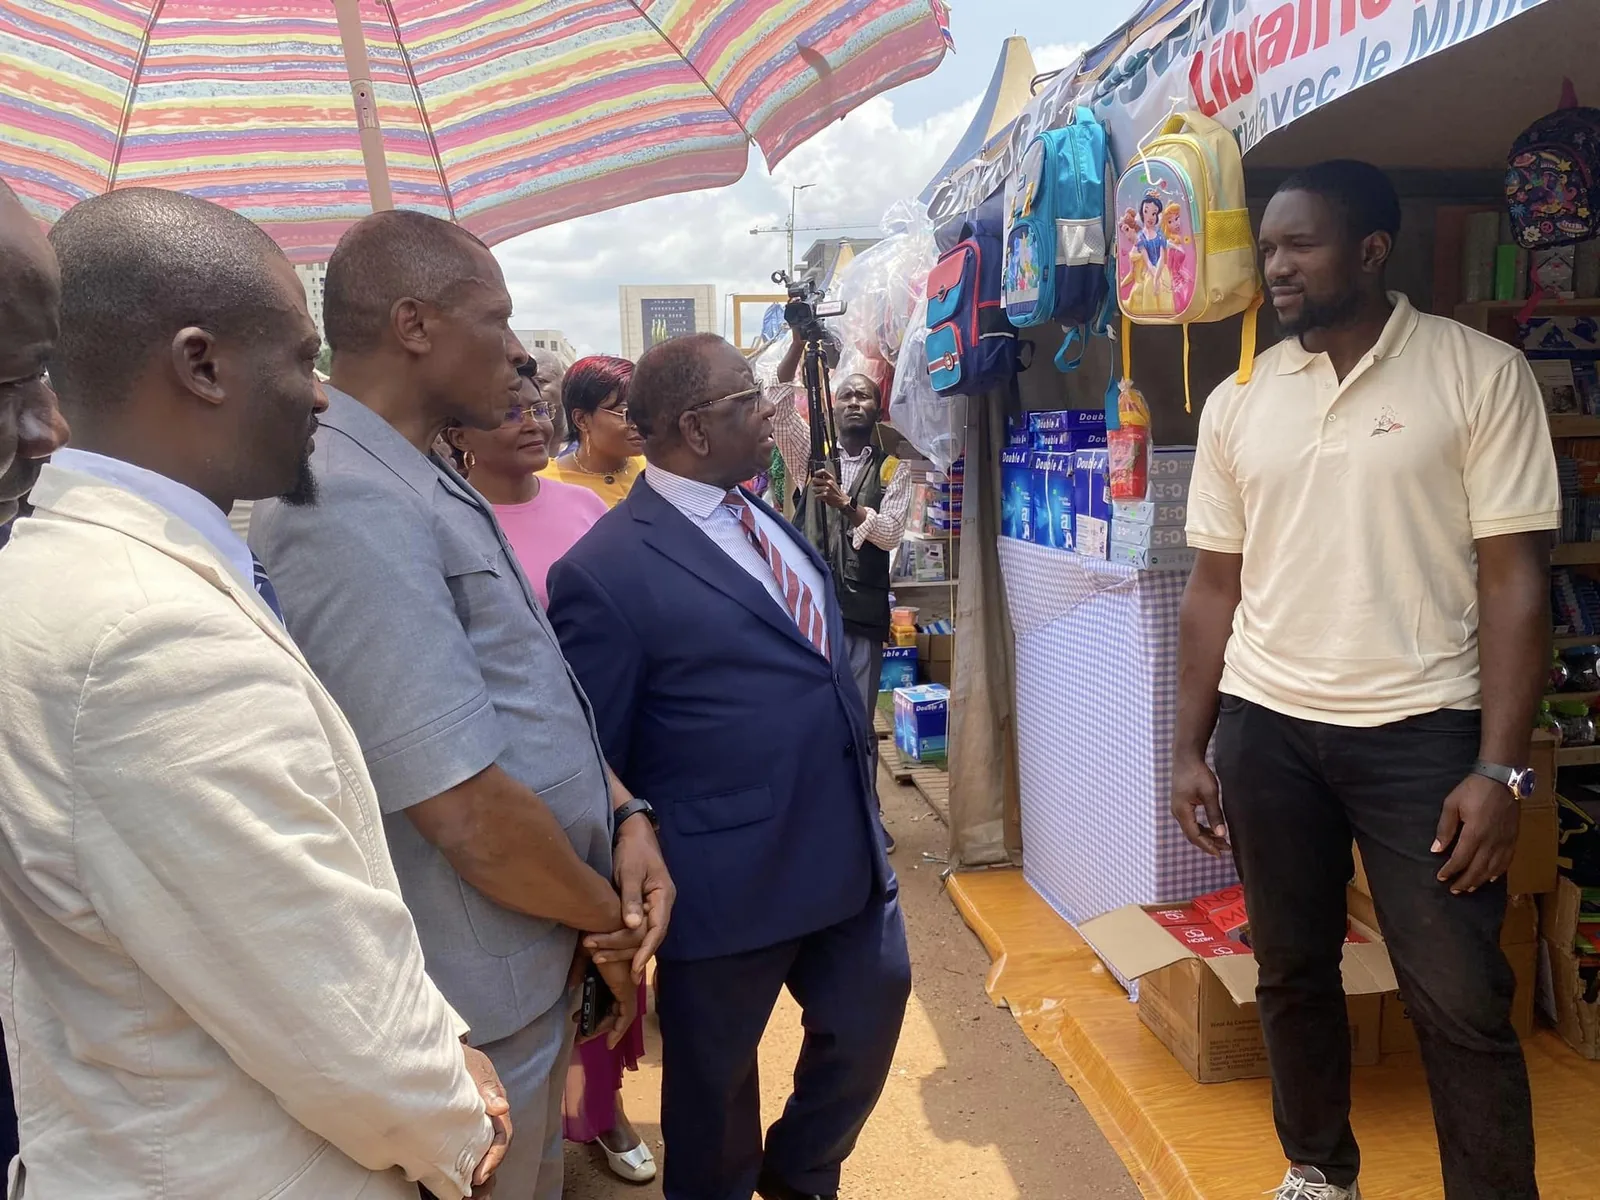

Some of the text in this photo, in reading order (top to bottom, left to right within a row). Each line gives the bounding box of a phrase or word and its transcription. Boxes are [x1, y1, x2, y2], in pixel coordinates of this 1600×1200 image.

[1347, 36, 1391, 92] le
[1079, 412, 1106, 421] Doub
[1087, 434, 1107, 443] Dou
[1002, 452, 1026, 463] Double A
